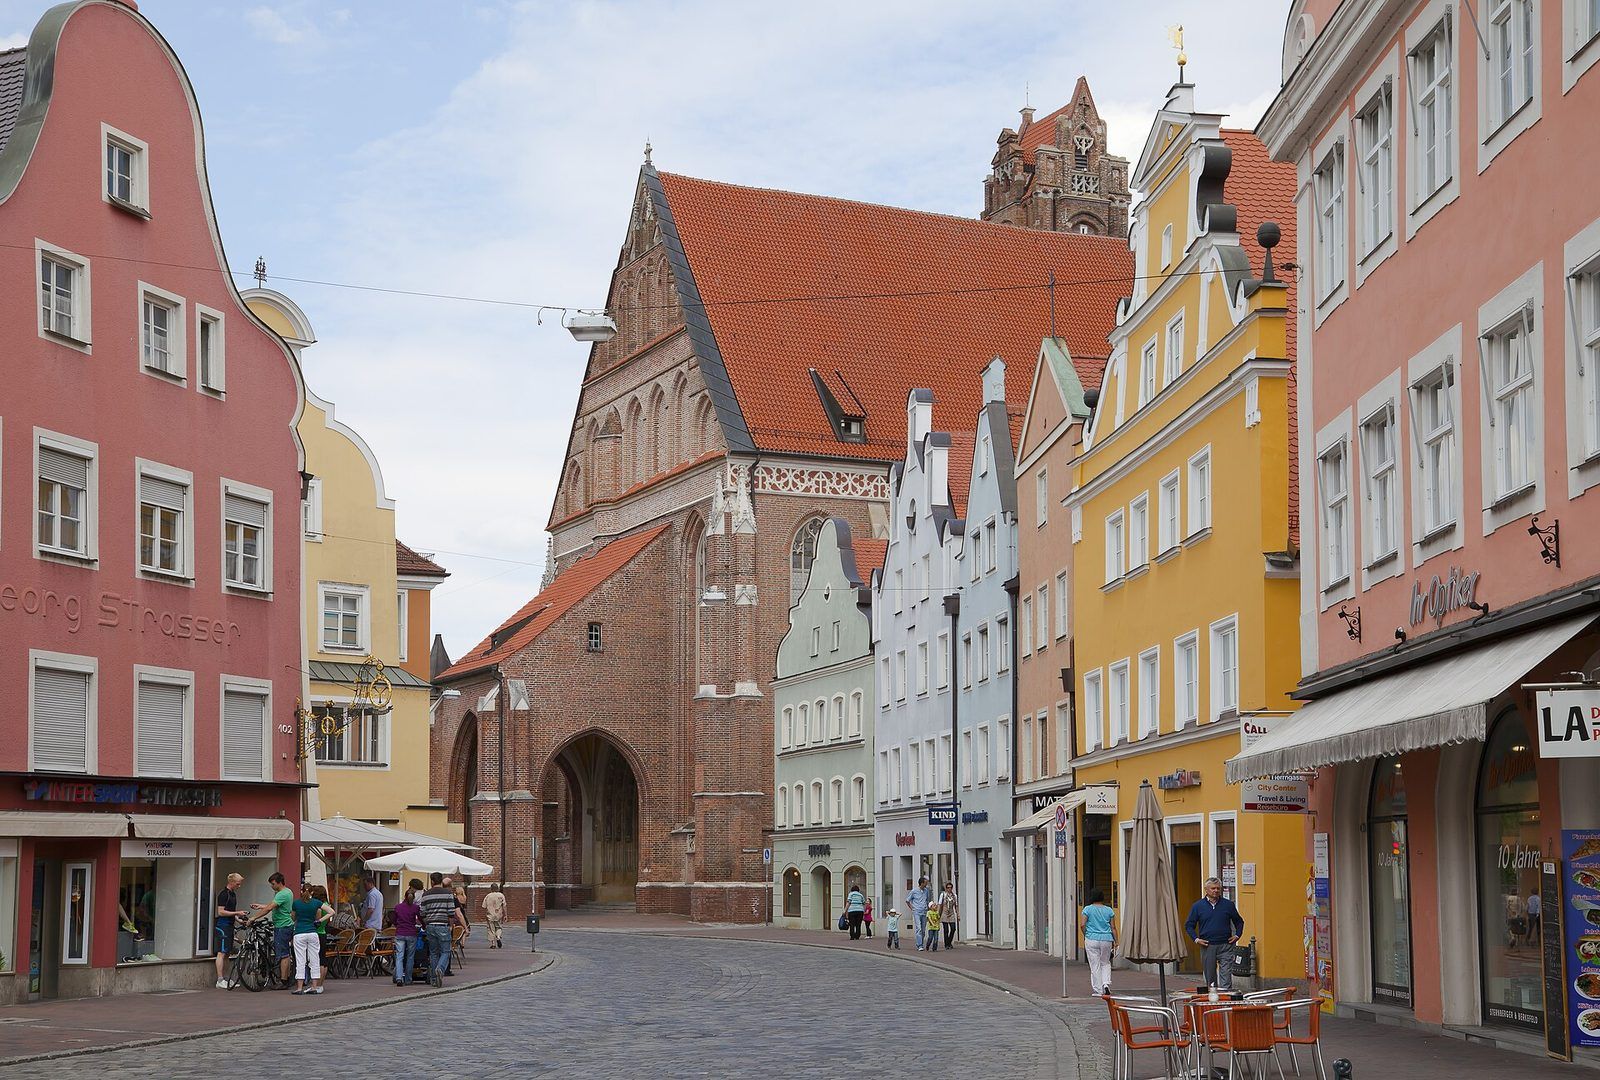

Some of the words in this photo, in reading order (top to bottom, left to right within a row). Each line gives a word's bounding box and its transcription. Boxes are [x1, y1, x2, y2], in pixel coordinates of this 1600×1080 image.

[1410, 579, 1428, 627] Ihr
[1428, 565, 1480, 628] Optiker
[277, 724, 293, 734] 102
[1244, 722, 1268, 734] CALL
[1541, 706, 1590, 742] LA
[1257, 784, 1272, 792] City
[1286, 795, 1306, 803] Living
[931, 811, 956, 819] KIND
[1498, 845, 1510, 869] 10
[1512, 845, 1540, 869] Jahre
